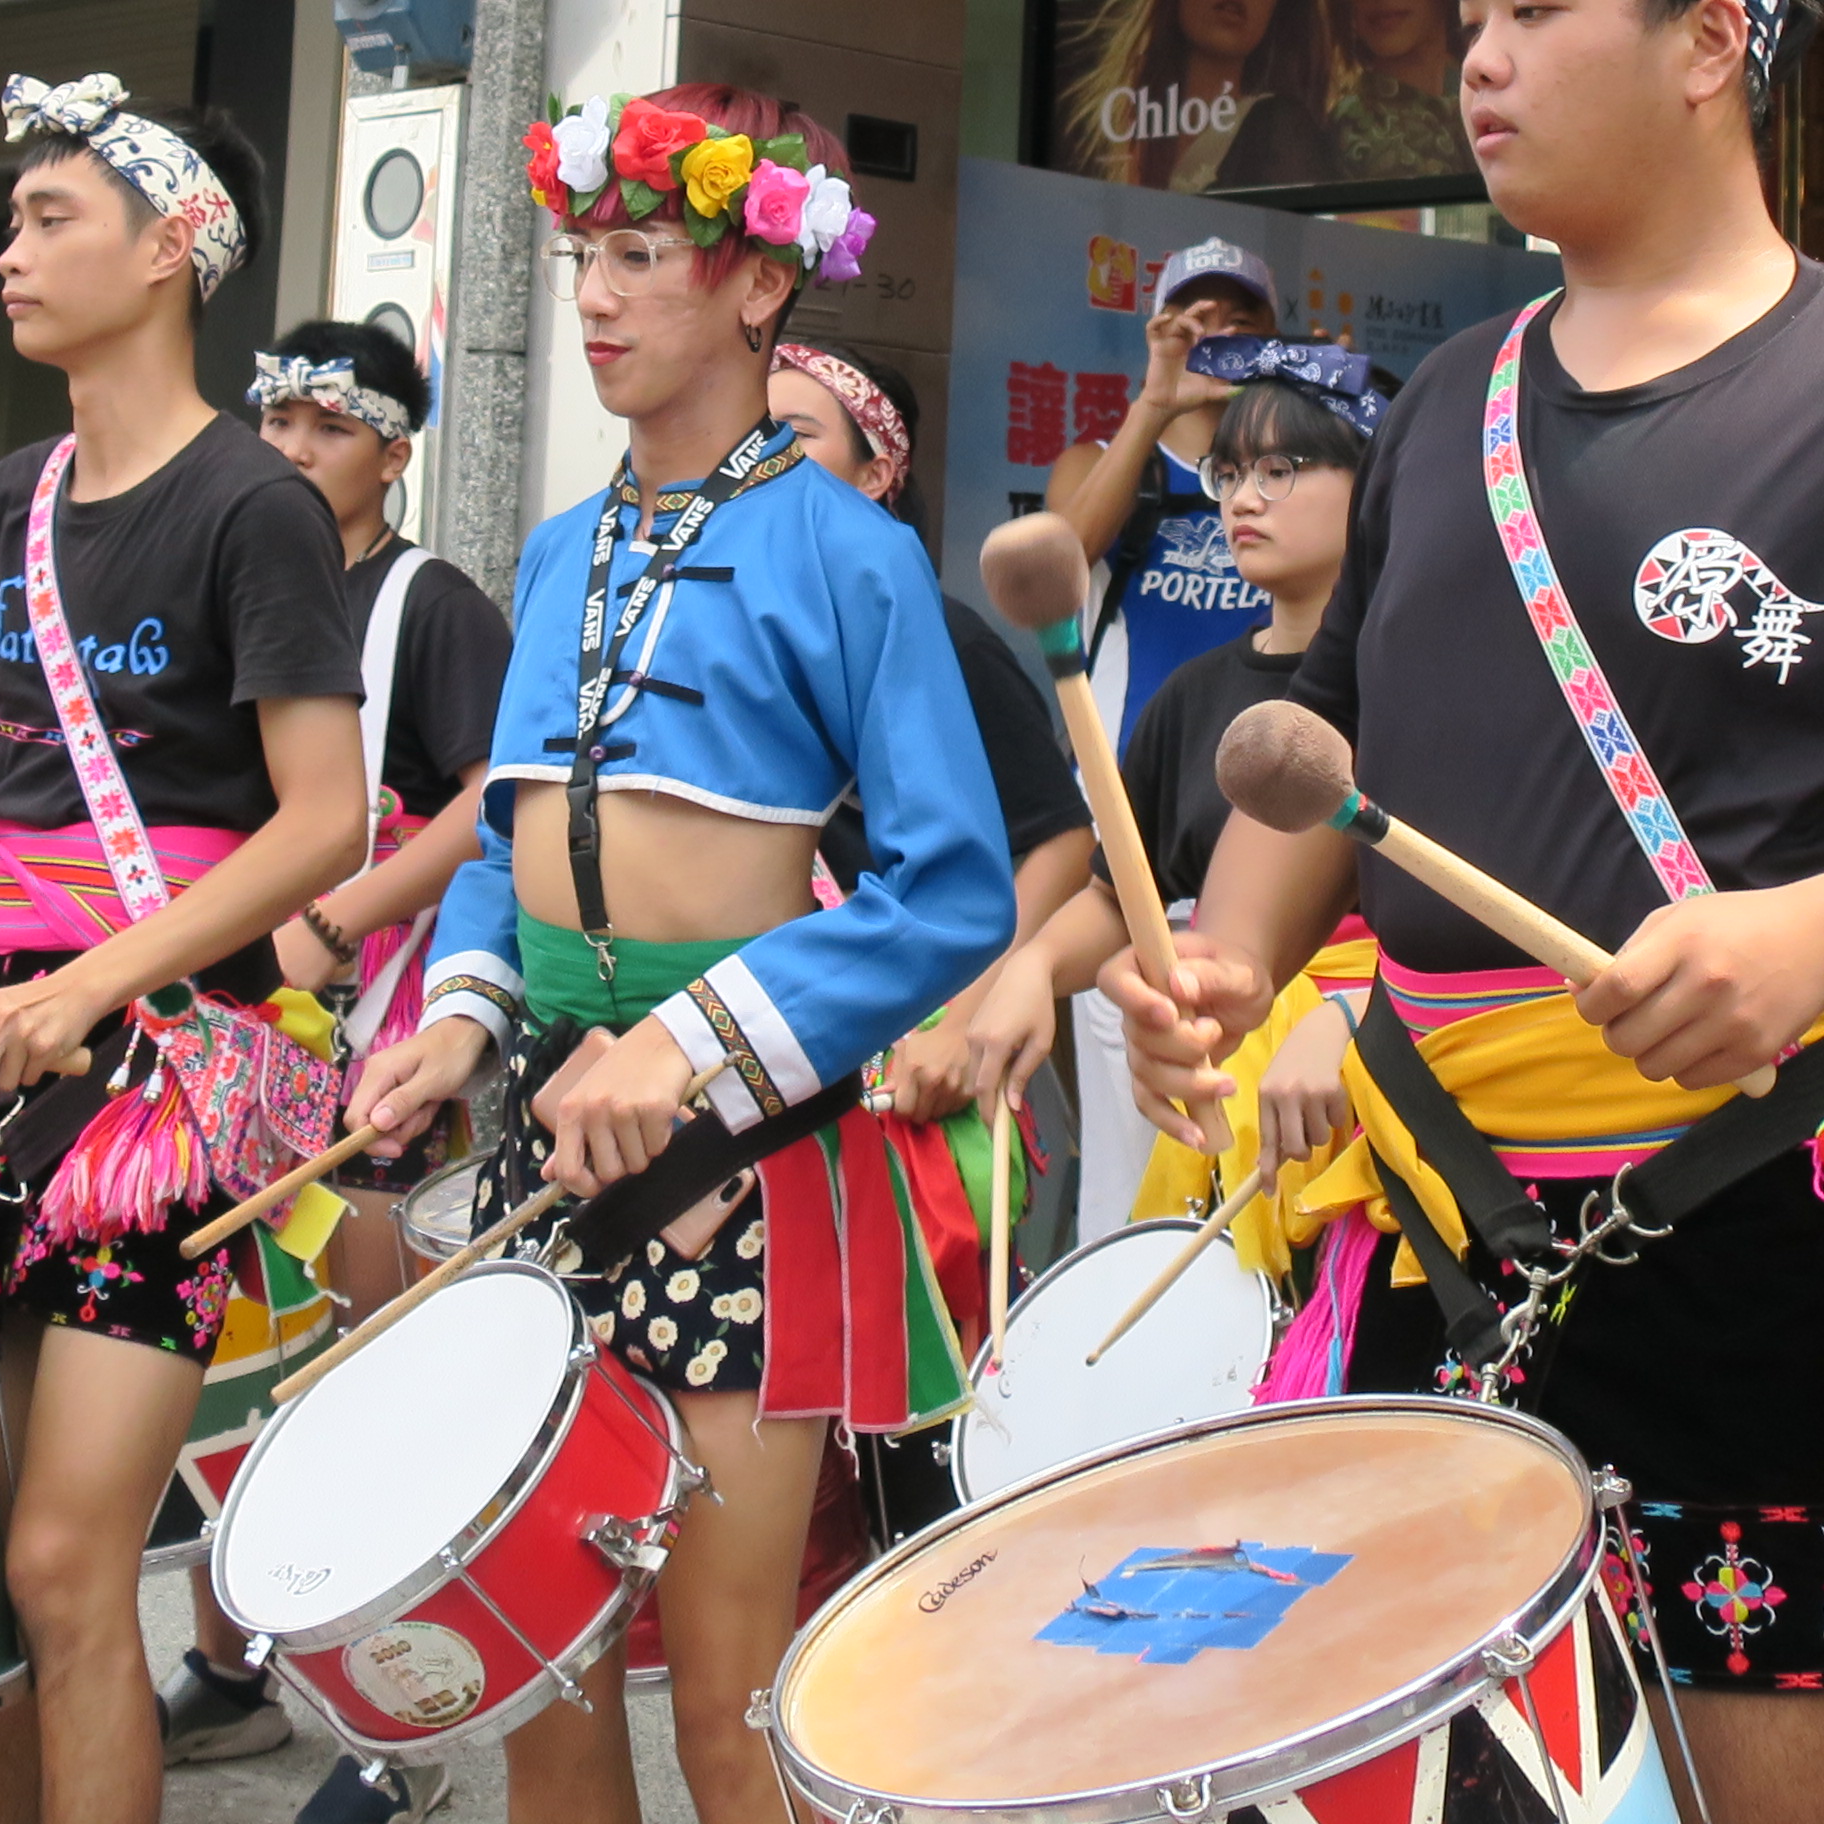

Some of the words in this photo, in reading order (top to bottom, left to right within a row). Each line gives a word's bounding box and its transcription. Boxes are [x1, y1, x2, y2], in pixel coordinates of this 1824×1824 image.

[1100, 81, 1238, 143] Chloé
[719, 429, 769, 481] VANS
[592, 504, 619, 567] VANS
[661, 494, 716, 552] VANS
[581, 587, 606, 653] VANS
[614, 575, 658, 638] VANS
[1139, 569, 1272, 611] PORTELA
[918, 1547, 999, 1614] Cadeson
